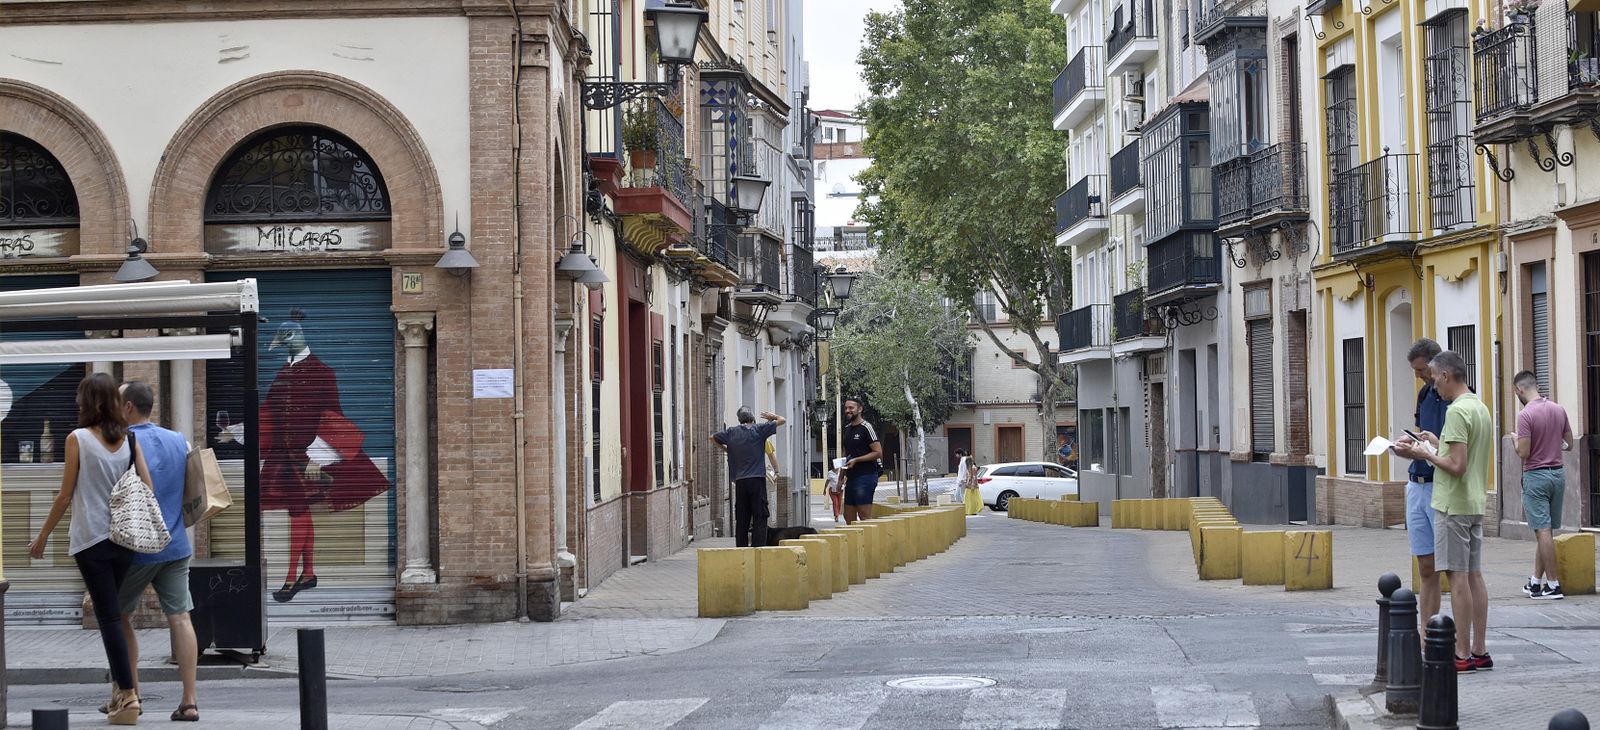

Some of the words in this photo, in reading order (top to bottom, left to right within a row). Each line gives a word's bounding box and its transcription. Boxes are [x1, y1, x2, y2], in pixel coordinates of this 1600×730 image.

[257, 225, 285, 249] Mil
[288, 226, 342, 249] CARAS
[1295, 532, 1319, 576] 4
